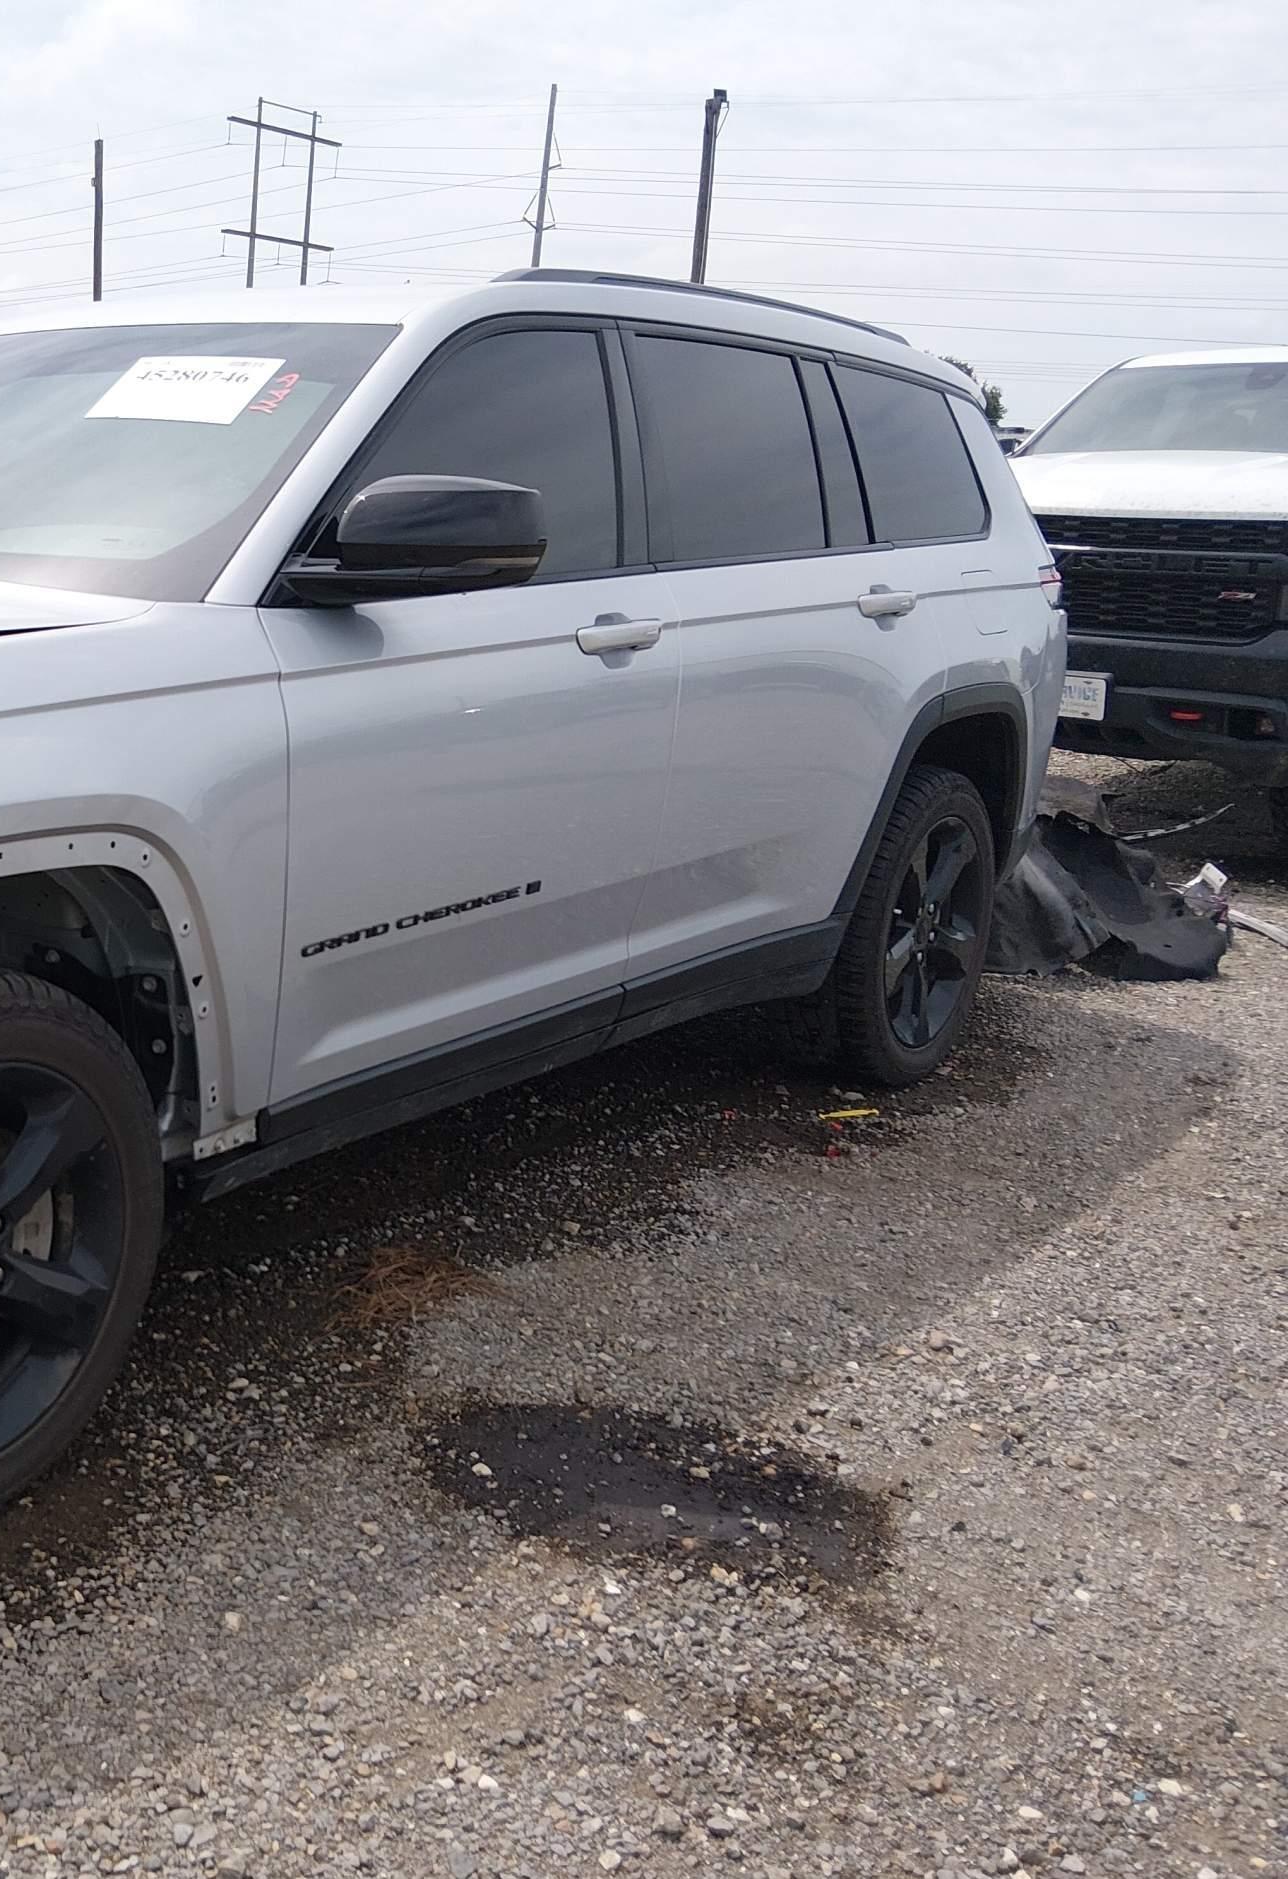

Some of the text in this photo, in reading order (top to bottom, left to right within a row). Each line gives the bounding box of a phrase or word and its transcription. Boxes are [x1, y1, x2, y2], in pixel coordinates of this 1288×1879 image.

[136, 368, 250, 384] 45280746
[301, 886, 521, 957] GRAND CHEROKEE
